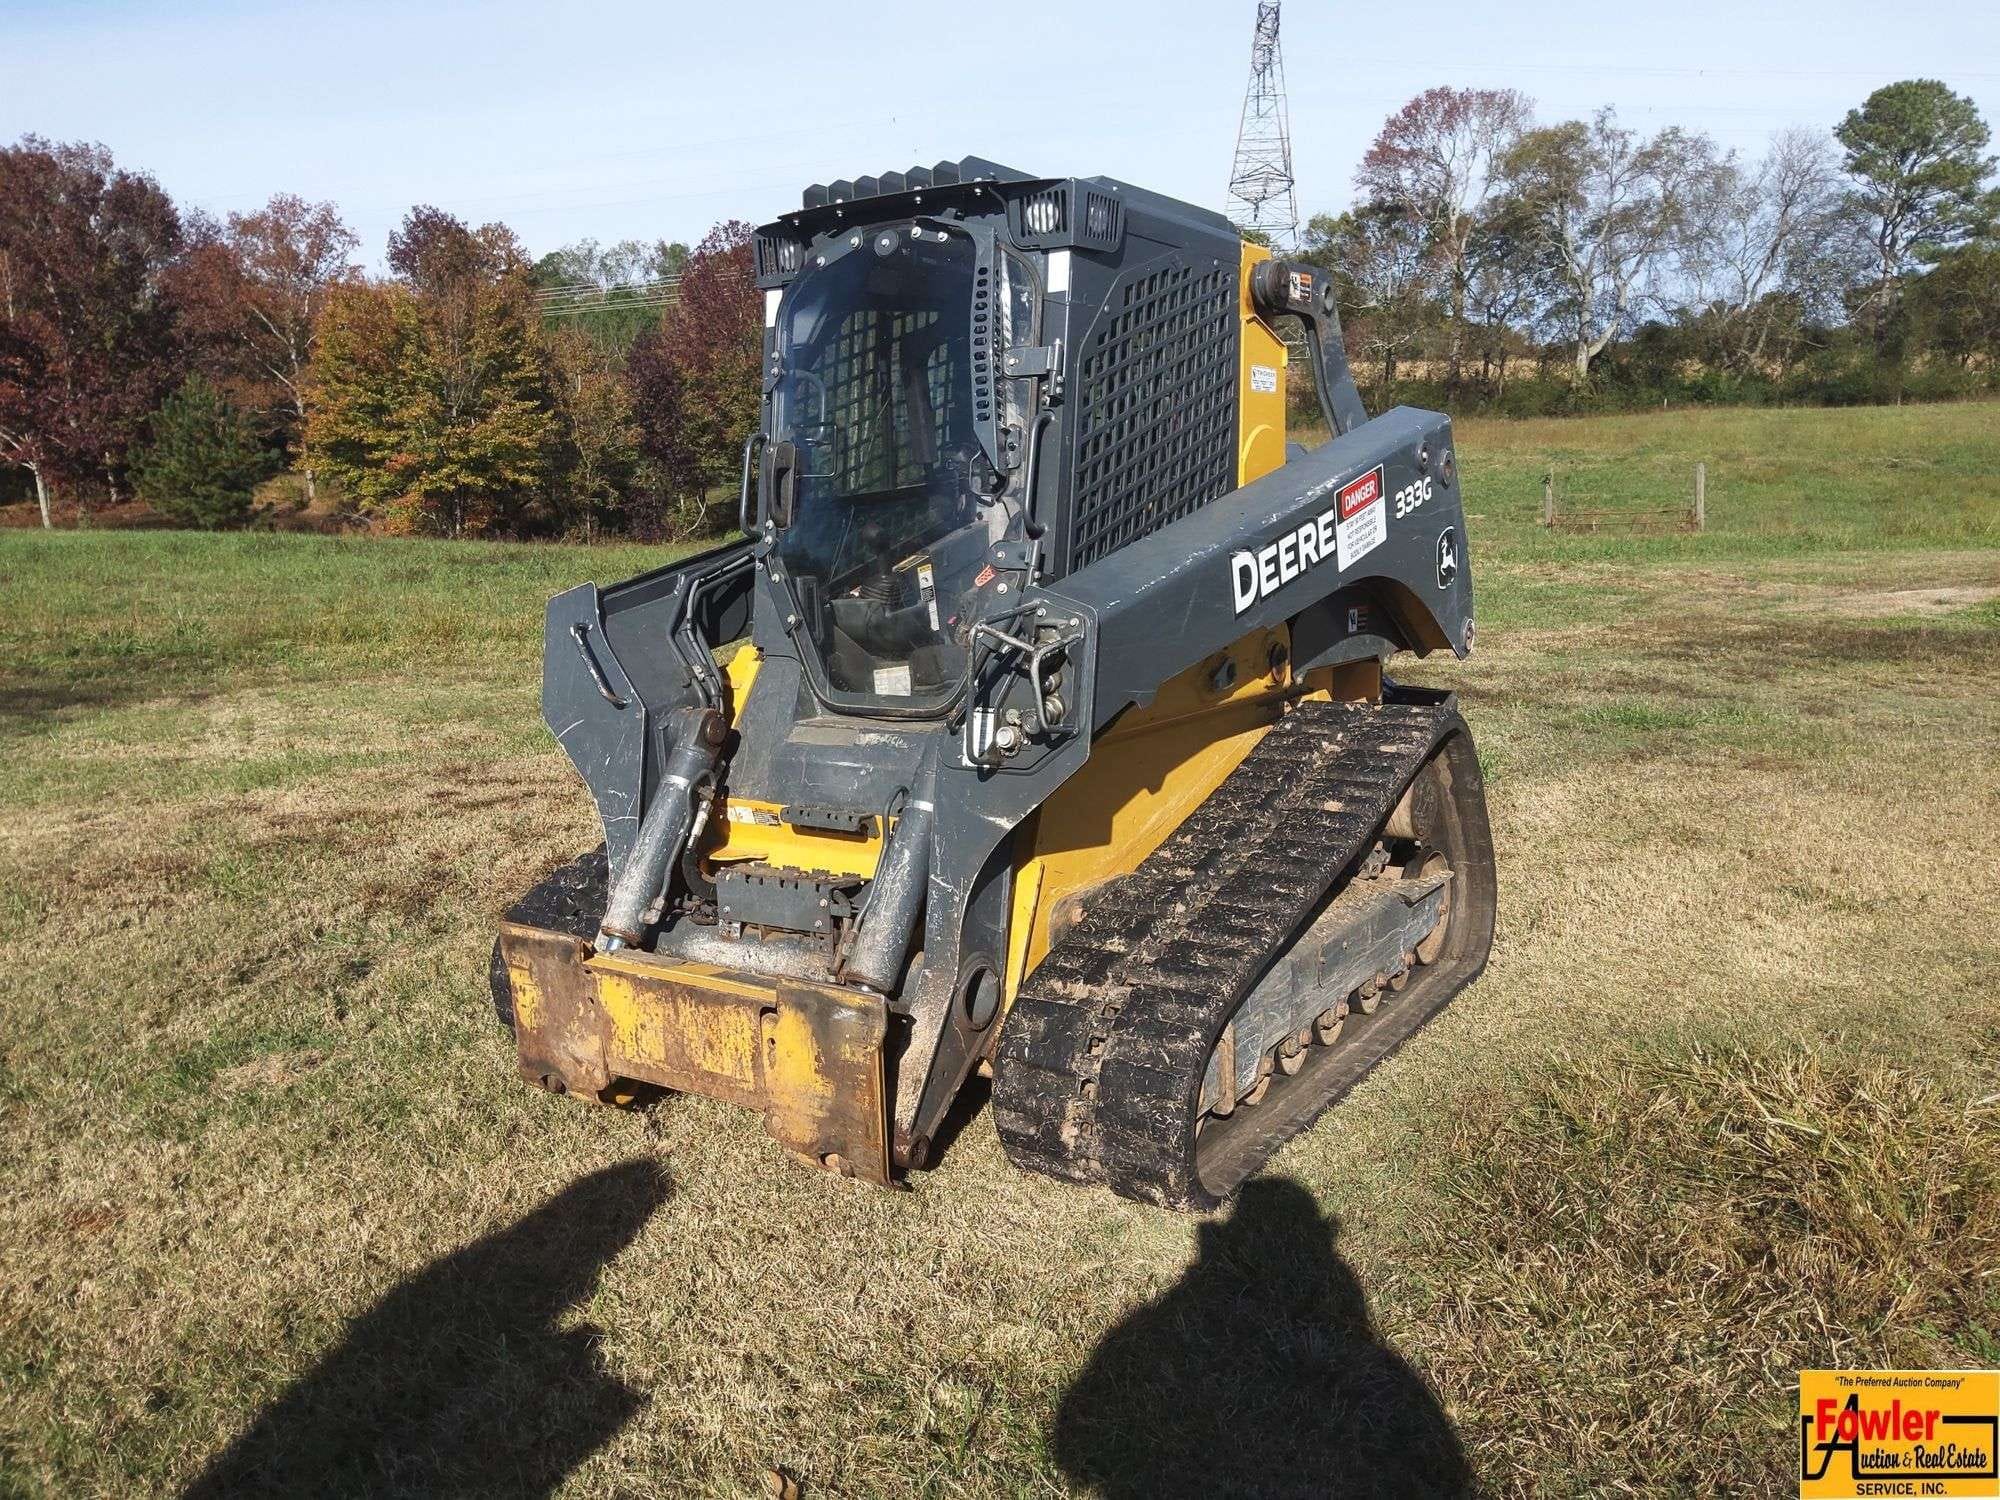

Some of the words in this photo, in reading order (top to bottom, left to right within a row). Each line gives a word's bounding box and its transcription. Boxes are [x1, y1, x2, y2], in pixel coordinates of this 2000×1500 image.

[1345, 480, 1375, 511] DANGER
[1395, 476, 1431, 519] 333G
[1232, 510, 1336, 615] DEERE
